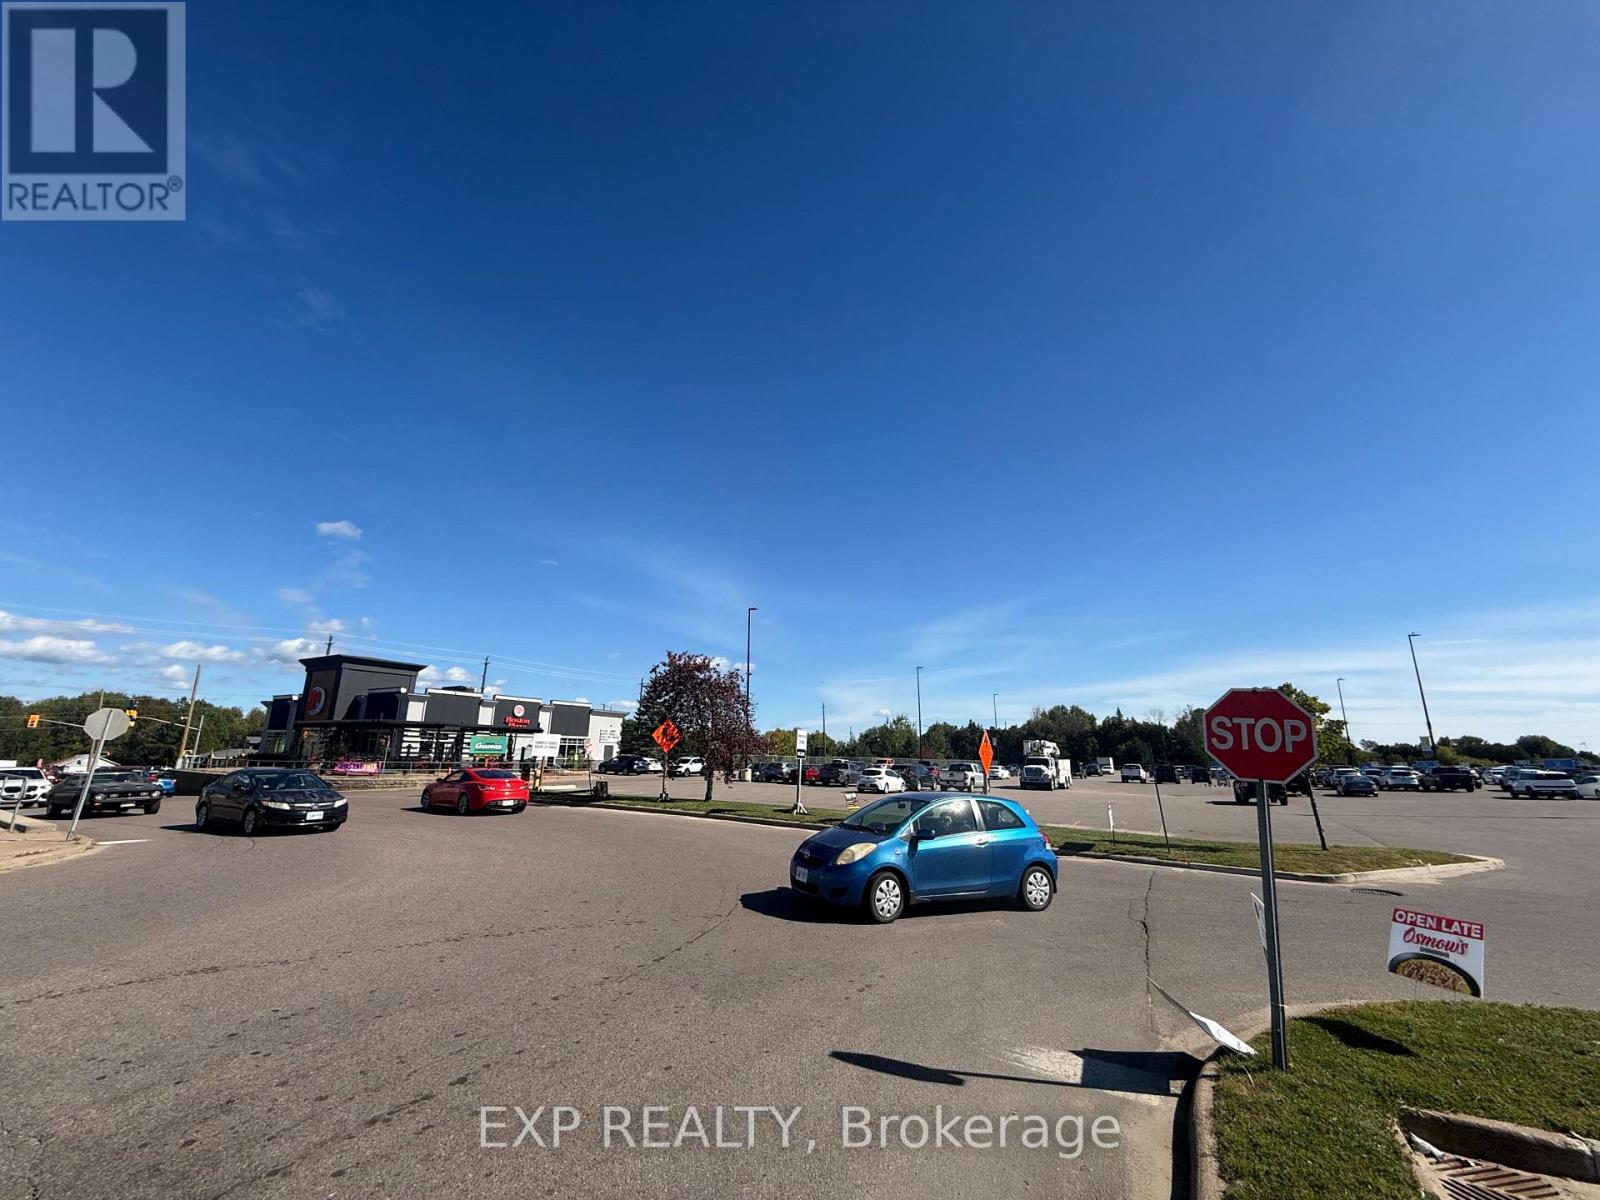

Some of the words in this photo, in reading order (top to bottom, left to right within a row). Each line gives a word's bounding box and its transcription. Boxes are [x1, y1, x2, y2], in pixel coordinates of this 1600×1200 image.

[1211, 716, 1307, 753] STOP
[1394, 910, 1438, 929] OPEN
[1440, 918, 1481, 938] LATE
